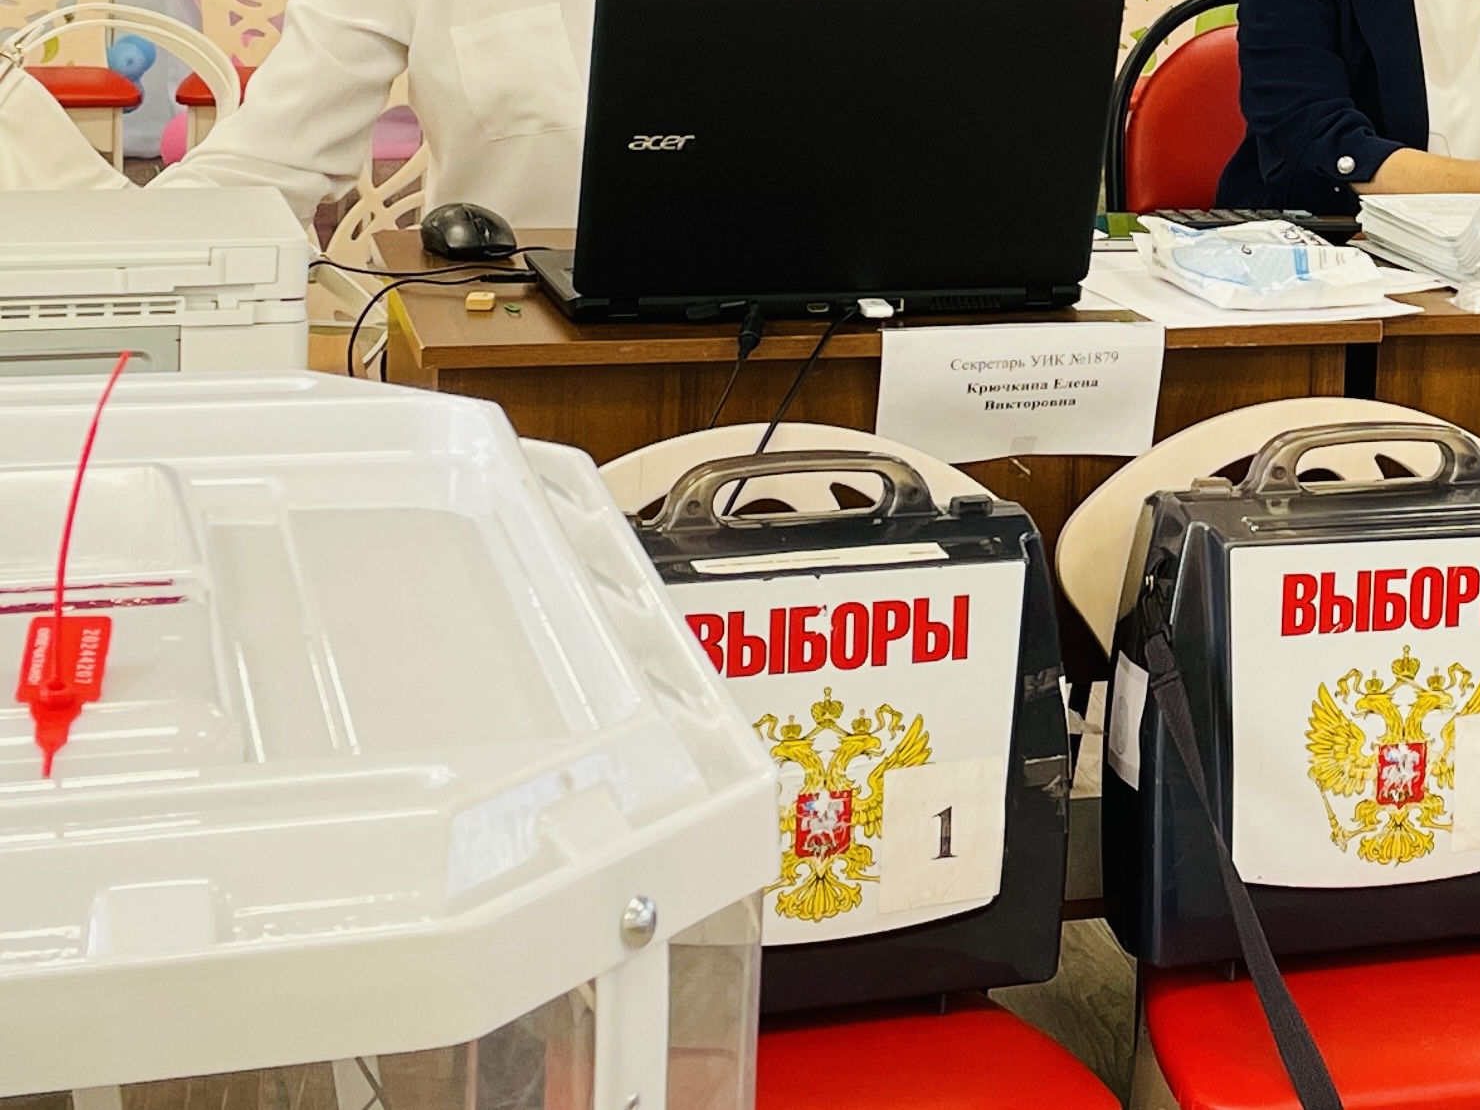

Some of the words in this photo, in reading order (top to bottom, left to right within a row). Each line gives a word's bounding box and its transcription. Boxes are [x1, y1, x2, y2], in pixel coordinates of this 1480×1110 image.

[628, 134, 696, 151] acer
[950, 355, 1025, 372] Секретарь
[1030, 353, 1065, 368] УИК
[1068, 351, 1119, 365] №1879
[966, 380, 1048, 396] Крючкина
[1053, 378, 1099, 391] Елена
[984, 397, 1076, 411] Викторовна
[74, 628, 102, 685] 20244207
[931, 805, 957, 861] 1
